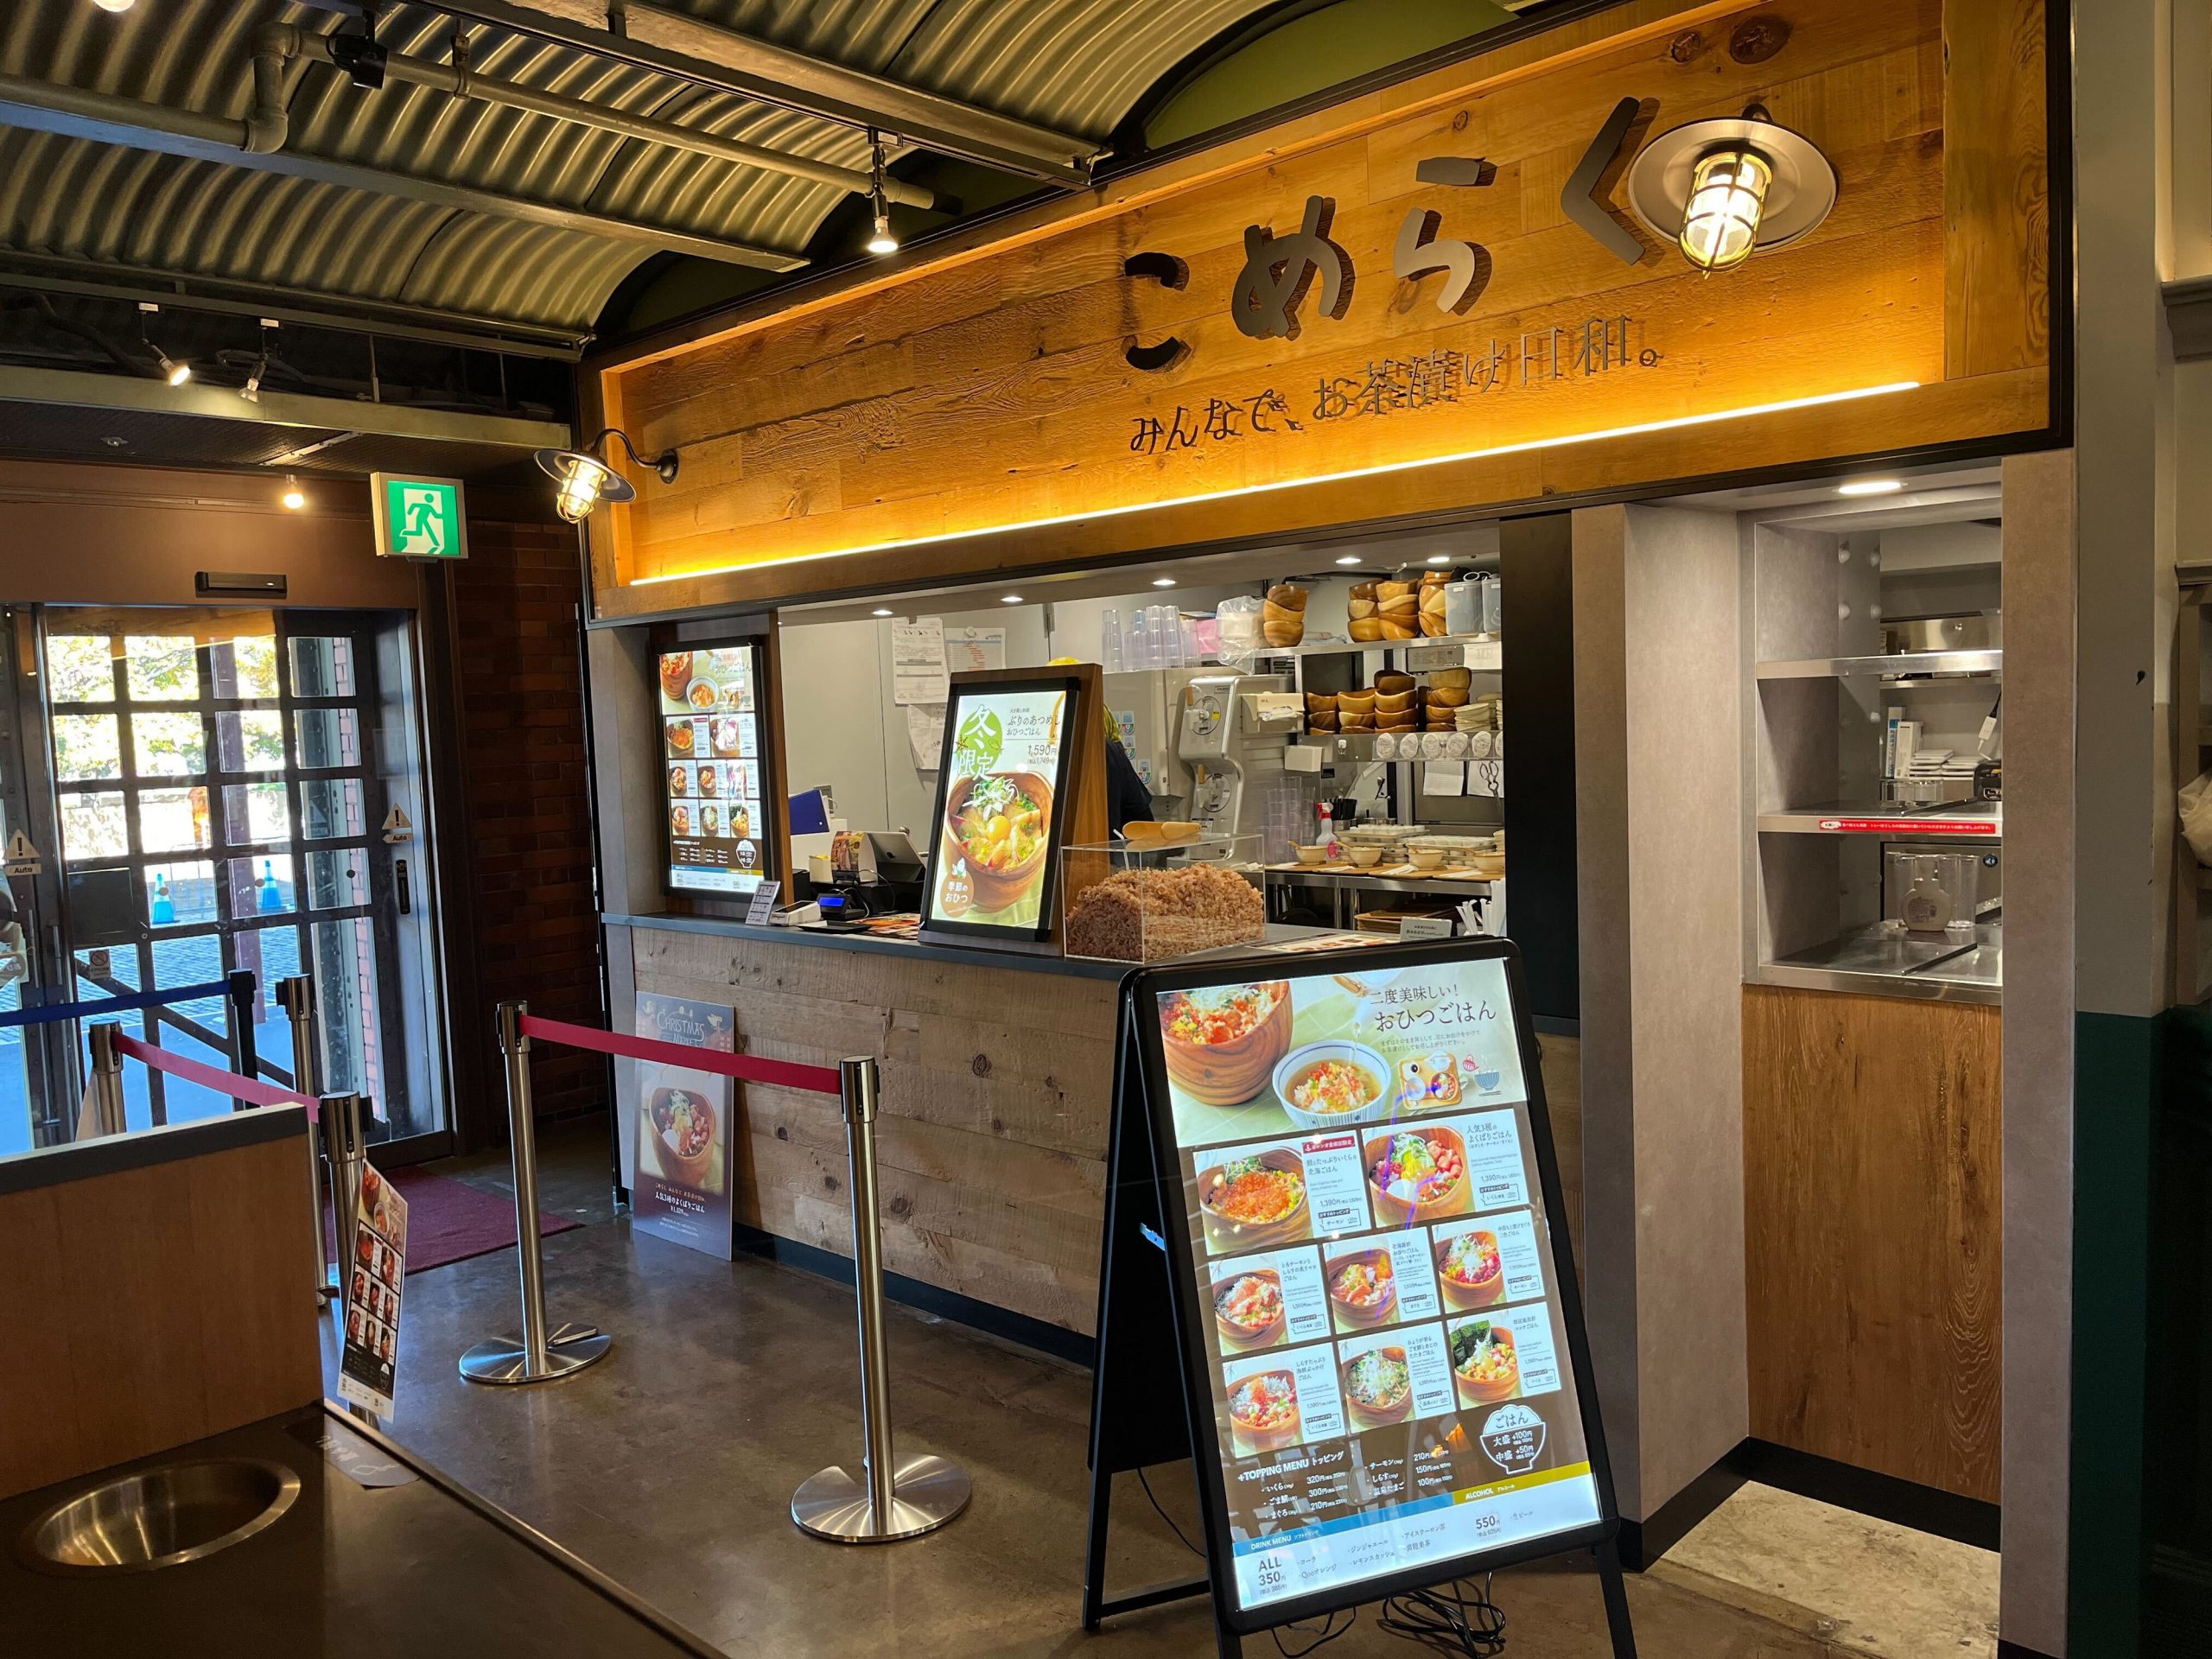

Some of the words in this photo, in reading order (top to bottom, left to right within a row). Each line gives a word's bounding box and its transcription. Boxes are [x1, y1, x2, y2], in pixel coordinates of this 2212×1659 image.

[1125, 96, 1646, 372] こめらく
[1130, 315, 1658, 454] みんなで、お茶漬け日和。
[963, 704, 996, 749] 冬
[1007, 714, 1060, 727] ぶりのあつめし
[1007, 728, 1041, 736] おひつごはん
[957, 748, 996, 781] 限定
[392, 833, 408, 842] Auto
[947, 880, 969, 893] 季節の
[944, 893, 969, 903] おひつ
[1368, 982, 1459, 1006] 二度美味しい！
[1373, 997, 1497, 1032] おひつごはん
[657, 1011, 705, 1042] CHRISTMAS
[1468, 1129, 1511, 1142] よくばりごはん
[1495, 1409, 1528, 1429] ごはん
[1492, 1433, 1510, 1446] 大盛
[1282, 1458, 1309, 1471] MENU
[1312, 1451, 1344, 1465] トッピング
[1495, 1449, 1513, 1462] 中盛
[1465, 1487, 1493, 1499] ALCOHOL
[1250, 1539, 1271, 1550] DRINK
[1272, 1535, 1291, 1545] MENU
[1257, 1555, 1281, 1572] ALL
